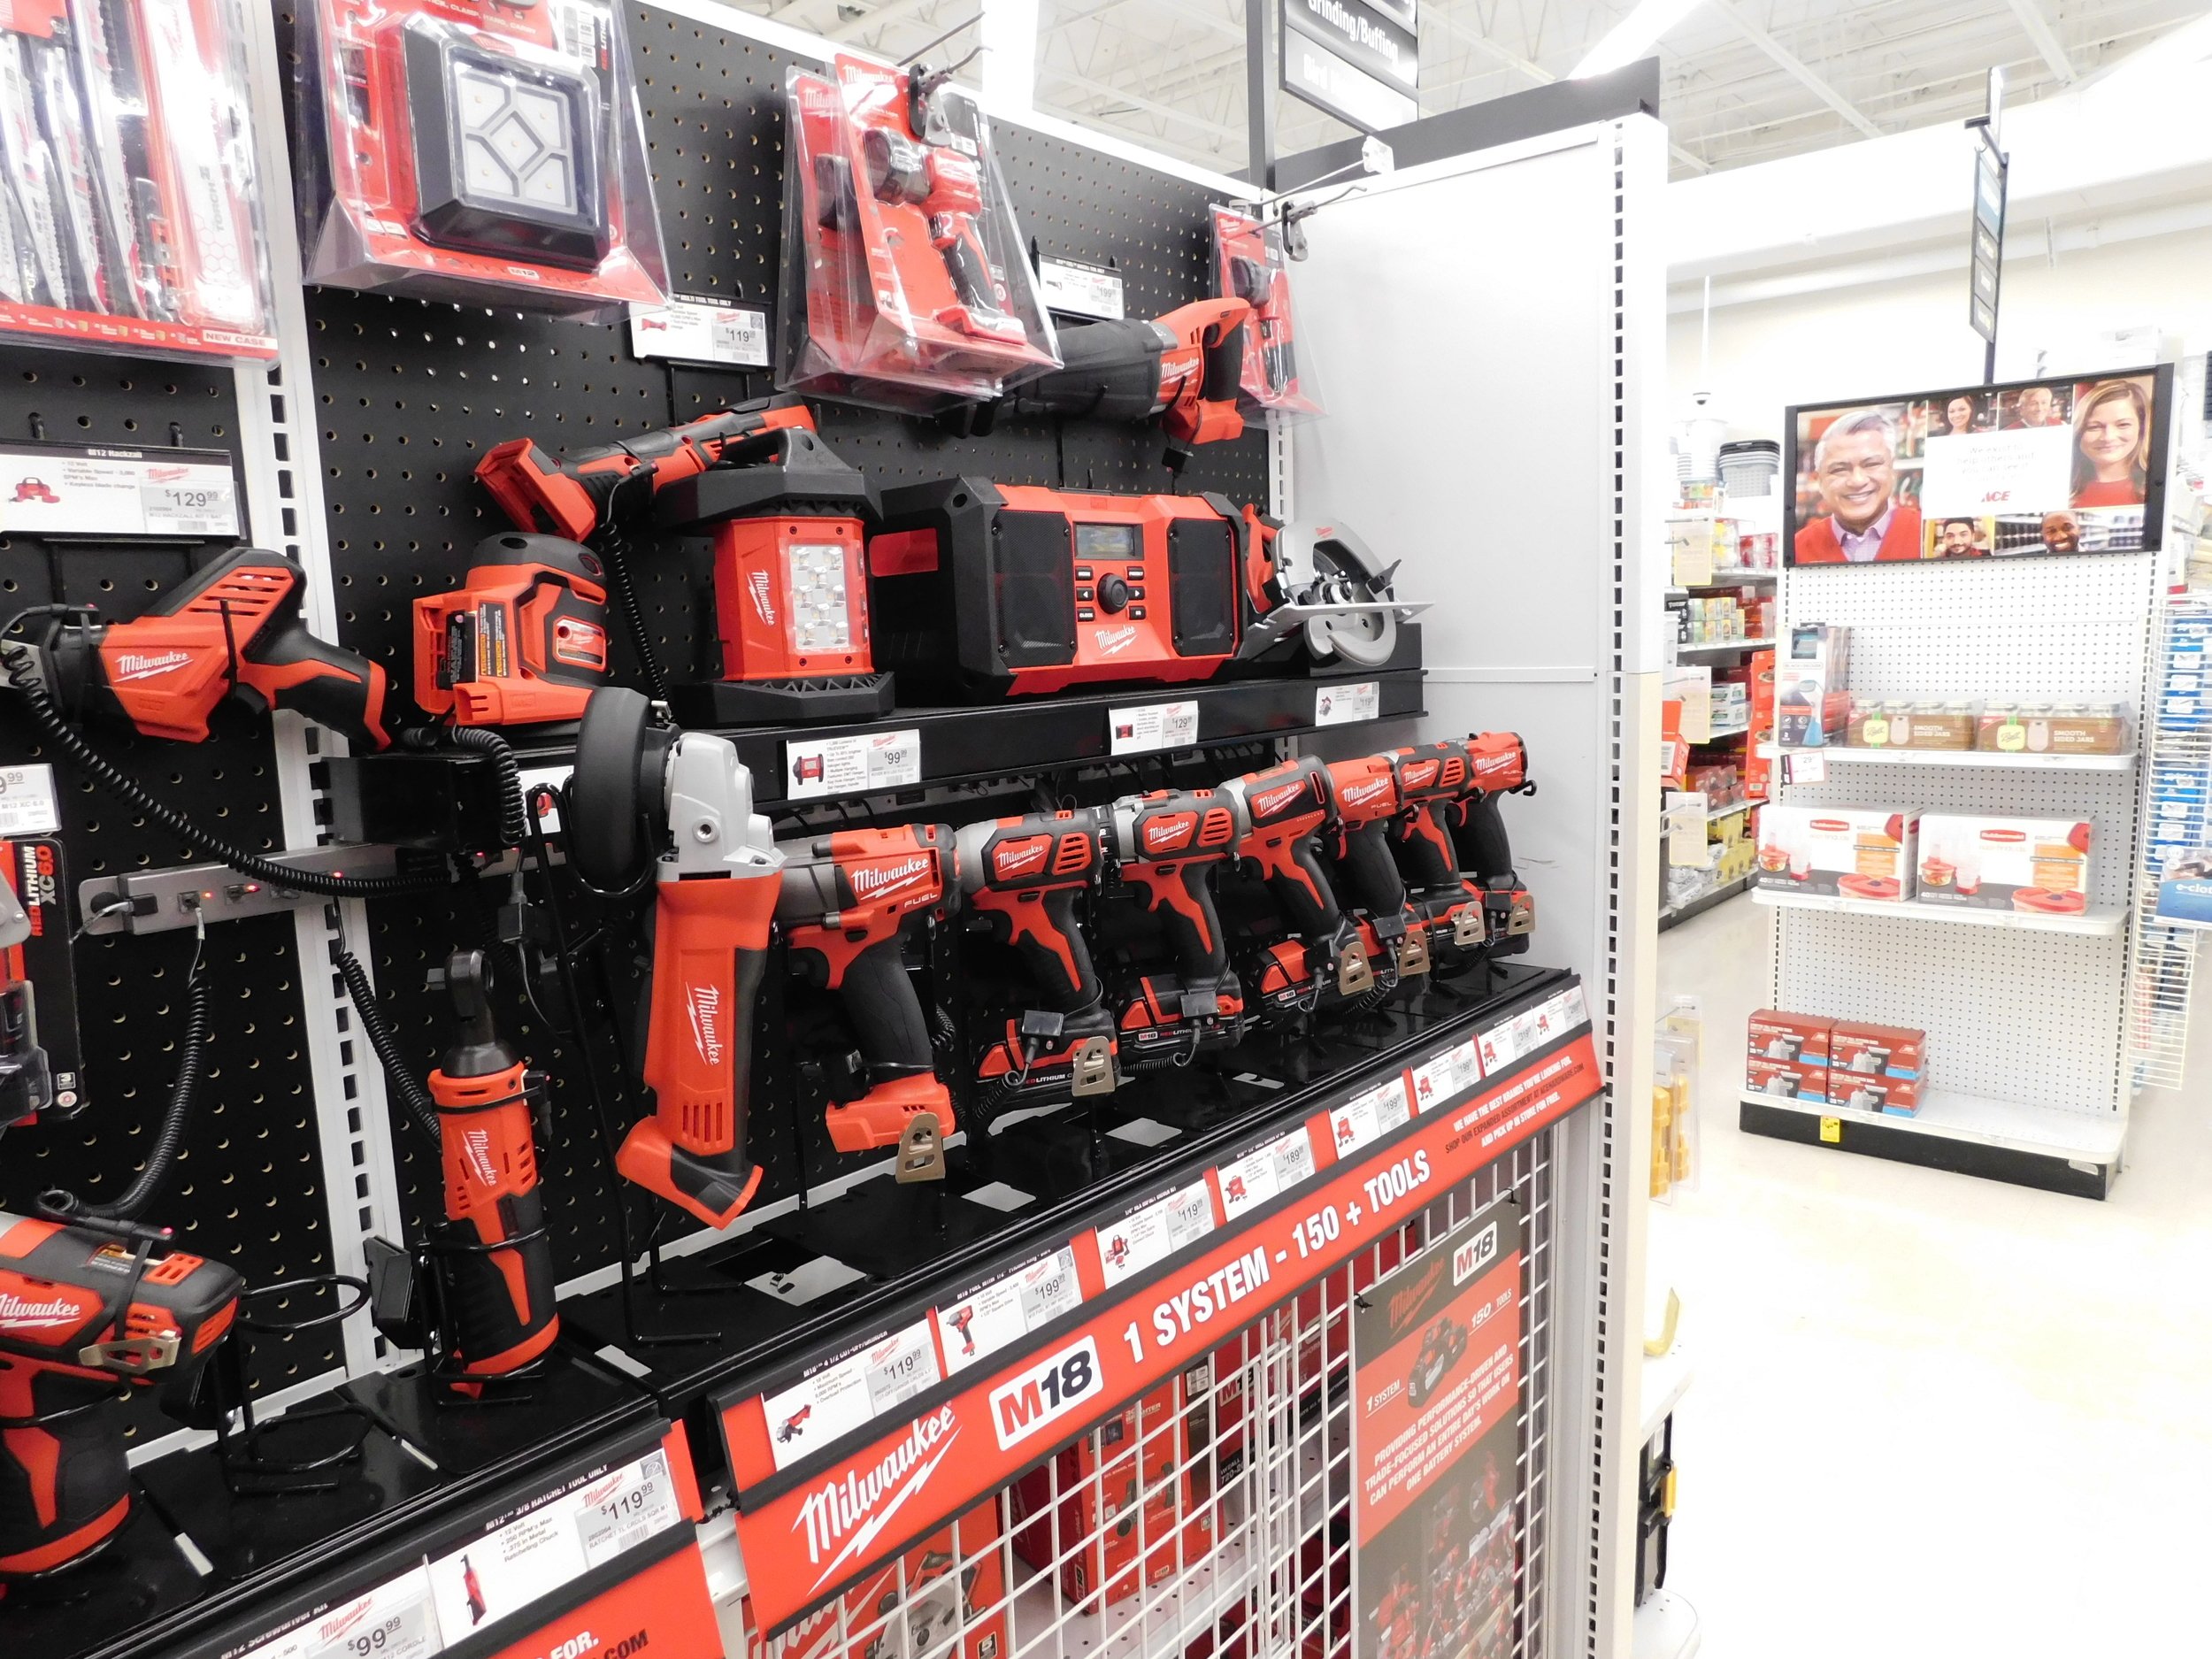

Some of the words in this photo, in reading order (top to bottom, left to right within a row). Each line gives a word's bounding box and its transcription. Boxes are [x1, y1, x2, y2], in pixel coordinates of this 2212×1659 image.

[205, 332, 232, 342] NEW
[234, 335, 267, 348] CASE
[1161, 357, 1200, 379] Milwaukee
[1980, 490, 2011, 503] ACE
[751, 569, 776, 628] Milwaukee
[1094, 625, 1136, 650] Milwaukee
[115, 651, 189, 674] Milwaukee
[1171, 718, 1187, 729] $129
[2001, 732, 2021, 743] Ball
[885, 752, 901, 765] $99
[1475, 752, 1517, 770] Milwaukee
[7, 772, 24, 783] 99
[1404, 765, 1434, 781] Milwaukee
[1257, 783, 1301, 811] Milwaukee
[1341, 778, 1389, 803] Milwaukee
[1148, 821, 1190, 841] Milwaukee
[996, 843, 1045, 866] Milwaukee
[851, 857, 929, 894] Milwaukee
[904, 892, 938, 908] FUEL
[695, 983, 720, 1066] Milwaukee
[1025, 1073, 1066, 1085] EDLITHIUM
[1445, 1139, 1460, 1154] SHOP
[1462, 1131, 1474, 1144] OUR
[1473, 1115, 1502, 1136] EXPANDED
[1502, 1094, 1534, 1120] ASSORTMENT
[1533, 1090, 1540, 1099] AT
[1540, 1063, 1585, 1094] ACEHARDWARE.COM
[1453, 1121, 1464, 1133] WE
[1463, 1112, 1479, 1126] HAVE
[1479, 1105, 1490, 1117] THE
[1489, 1097, 1503, 1111] BEST
[1503, 1083, 1525, 1103] BRANDS
[1523, 1073, 1542, 1090] YOU'RE
[1540, 1061, 1562, 1079] LOOKING
[1560, 1056, 1572, 1069] FOR.
[1481, 1134, 1494, 1148] AND
[1494, 1124, 1507, 1140] PICK
[1505, 1120, 1514, 1133] UP
[1513, 1116, 1521, 1126] IN
[1520, 1105, 1537, 1123] STORE
[1536, 1099, 1548, 1112] FOR
[1546, 1091, 1561, 1106] FREE.
[466, 1128, 496, 1187] Milwaukee
[1283, 1149, 1300, 1166] $189
[1178, 1203, 1198, 1223] $119
[1124, 1321, 1144, 1363] 1
[1153, 1255, 1271, 1347] SYSTEM
[1292, 1211, 1340, 1256] 150
[1346, 1202, 1362, 1227] +
[1363, 1148, 1431, 1215] TOOLS
[1455, 1230, 1494, 1279] M18
[1035, 1279, 1060, 1300] $199
[1388, 1256, 1447, 1329] Milwaukee
[1471, 1302, 1492, 1328] 150
[1495, 1288, 1512, 1310] TOOLS
[870, 1337, 900, 1364] Milwaukee
[884, 1356, 914, 1379] $119
[912, 1348, 922, 1360] 99
[999, 1349, 1093, 1438] M18
[1366, 1395, 1373, 1412] 1
[1374, 1379, 1401, 1407] SYSTEM
[1374, 1423, 1417, 1467] PROVIDING
[1417, 1358, 1494, 1431] PERFORMANCE-DRIVEN
[1494, 1343, 1508, 1363] AND
[1365, 1430, 1429, 1492] TRADE-FOCUSED
[1429, 1396, 1467, 1438] SOLUTIONS
[1467, 1388, 1478, 1402] SO
[1478, 1375, 1493, 1394] THAT
[1493, 1353, 1514, 1379] USERS
[1370, 1486, 1387, 1506] CAN
[1388, 1455, 1425, 1492] PERFORM
[1425, 1441, 1437, 1458] AN
[1437, 1417, 1462, 1445] ENTIRE
[1463, 1400, 1482, 1424] DAY'S
[1482, 1385, 1501, 1407] WORK
[1501, 1372, 1511, 1387] ON
[1406, 1471, 1422, 1492] ONE
[1423, 1443, 1454, 1478] BATTERY
[1454, 1415, 1482, 1448] SYSTEM.
[516, 1503, 530, 1516] 3/8
[530, 1486, 566, 1509] RATCHET
[568, 1476, 588, 1490] TOOL
[588, 1464, 609, 1481] ONLY
[580, 1472, 624, 1508] Milwaukee
[791, 1404, 956, 1565] Milwaukee
[601, 1491, 643, 1521] $119
[641, 1481, 654, 1494] 99
[512, 1521, 526, 1532] Volt
[528, 1528, 546, 1541] Metal
[539, 1517, 554, 1526] Max
[504, 1544, 539, 1563] Ratcheting
[538, 1531, 559, 1544] Chuck
[589, 1532, 618, 1549] RATCHET
[318, 1595, 373, 1640] Milwaukee
[283, 1644, 298, 1656] 500
[348, 1627, 388, 1657] $99
[385, 1616, 402, 1632] 99
[549, 1630, 600, 1659] FOR.
